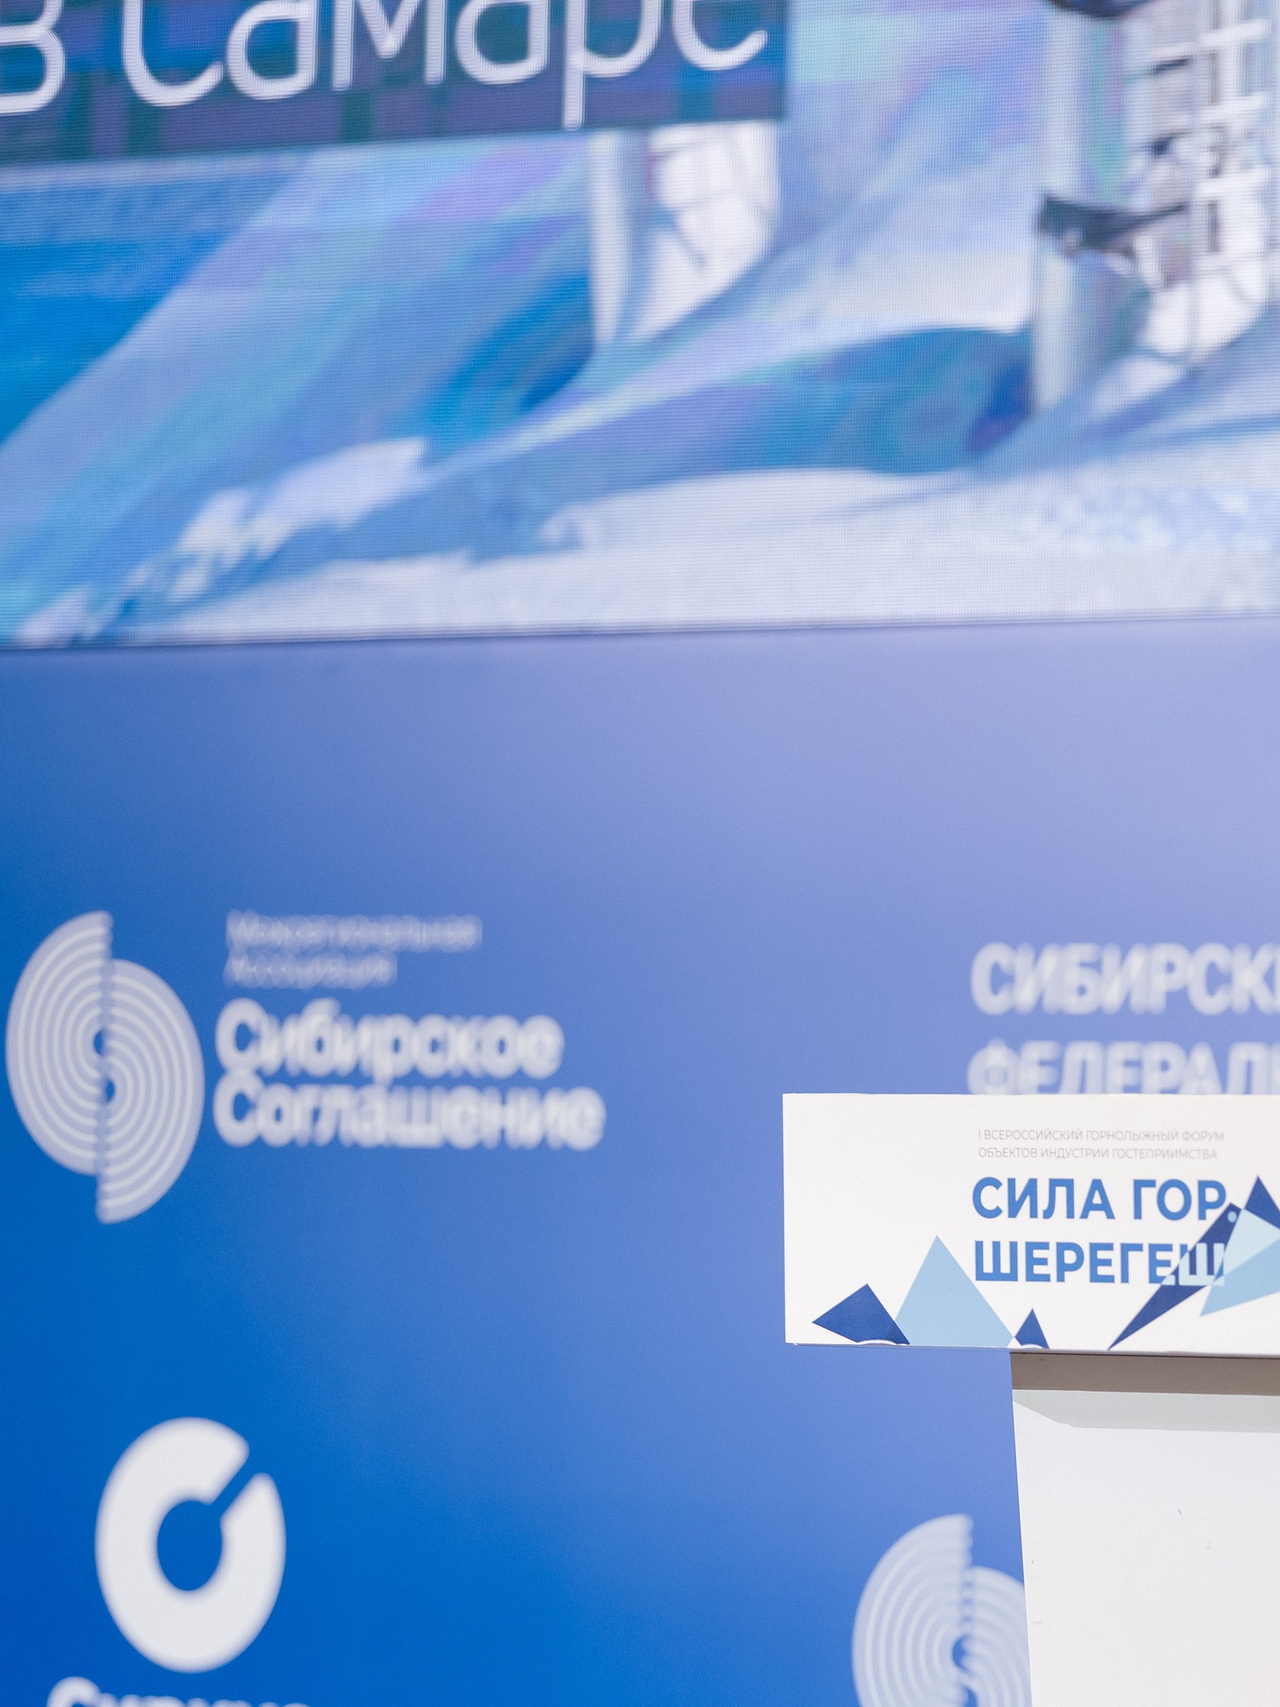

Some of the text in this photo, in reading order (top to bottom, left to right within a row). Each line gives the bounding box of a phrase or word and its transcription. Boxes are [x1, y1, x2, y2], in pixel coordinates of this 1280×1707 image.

[216, 998, 564, 1084] Сибирское
[213, 1071, 606, 1151] Соглашение
[978, 1147, 1218, 1160] ОБЪЕКТОВ ИНДУСТРИИ ГОСТЕПРИИМСТВА
[983, 1128, 1083, 1141] ВСЕРОССИЙСКИЙ
[1086, 1129, 1179, 1141] ГОРНОЛЫЖНЫЙ
[1181, 1131, 1225, 1142] ФОРУМ
[972, 1176, 1116, 1219] СИЛА
[974, 1240, 1226, 1287] ШЕРЕГЕШ
